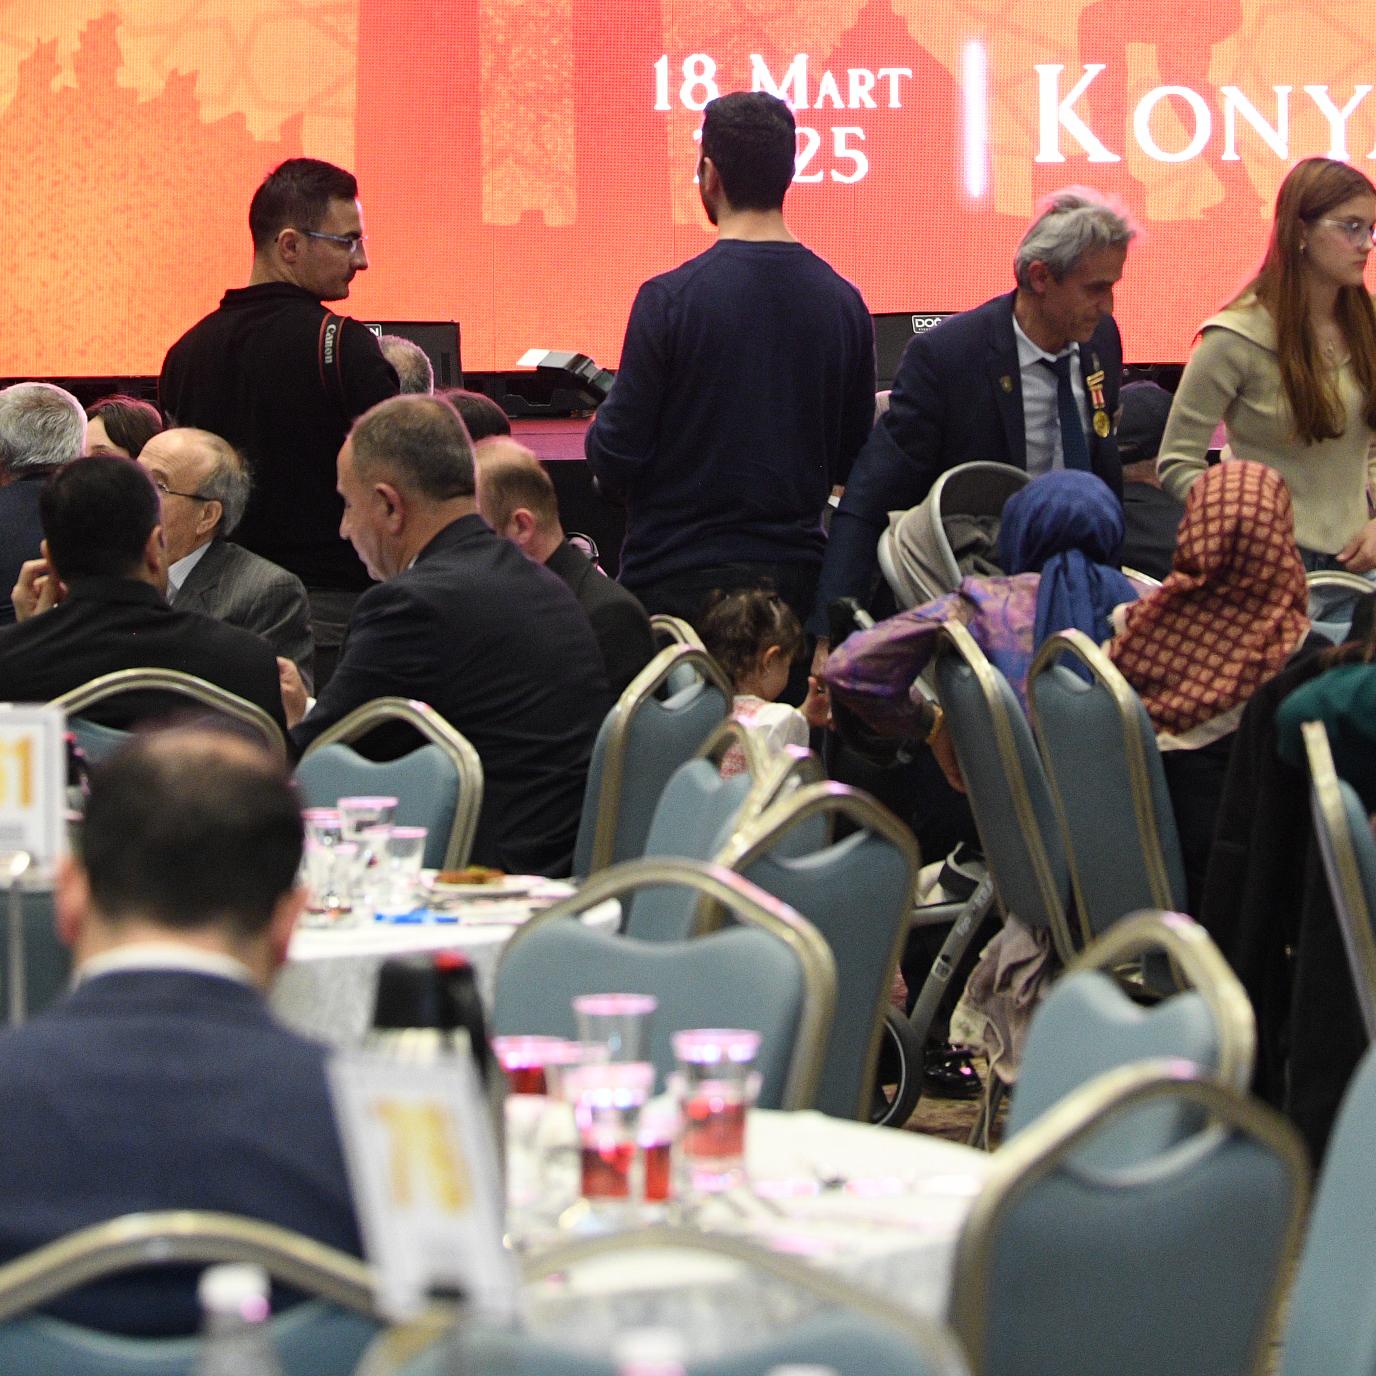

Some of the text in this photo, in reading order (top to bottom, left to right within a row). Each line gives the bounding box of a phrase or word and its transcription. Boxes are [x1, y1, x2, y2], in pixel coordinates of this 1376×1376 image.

[653, 52, 913, 112] 18 MART
[915, 317, 942, 328] DOĞ
[324, 324, 337, 364] Canon
